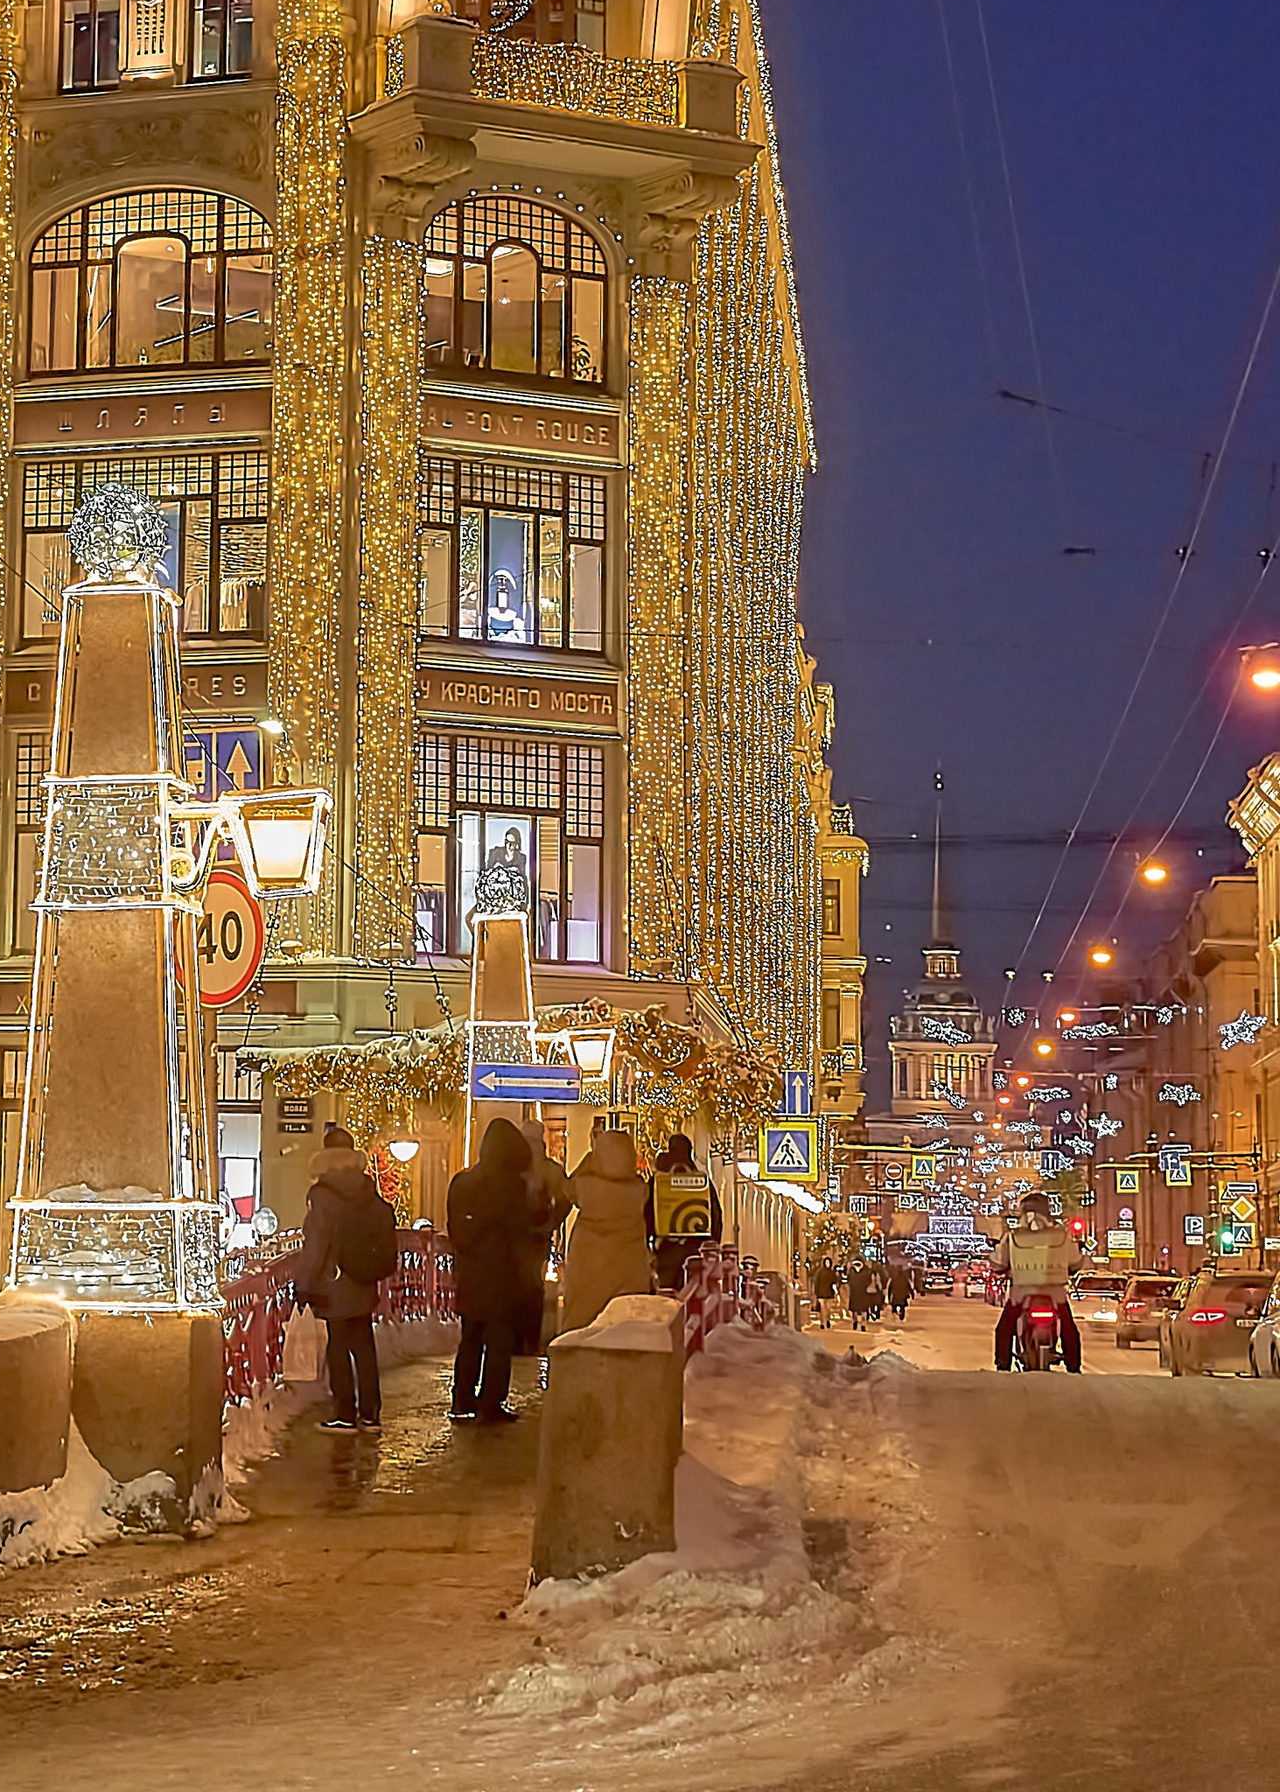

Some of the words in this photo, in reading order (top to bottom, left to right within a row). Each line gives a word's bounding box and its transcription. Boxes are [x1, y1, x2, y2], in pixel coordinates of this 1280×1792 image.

[59, 402, 226, 430] ШЛЯПЫ
[427, 408, 453, 428] AU
[466, 411, 523, 436] PONT
[536, 419, 611, 446] ROUGE
[420, 680, 431, 699] У
[440, 681, 540, 709] КРАСНАГО
[551, 690, 613, 715] МОСТА
[196, 910, 243, 964] 40
